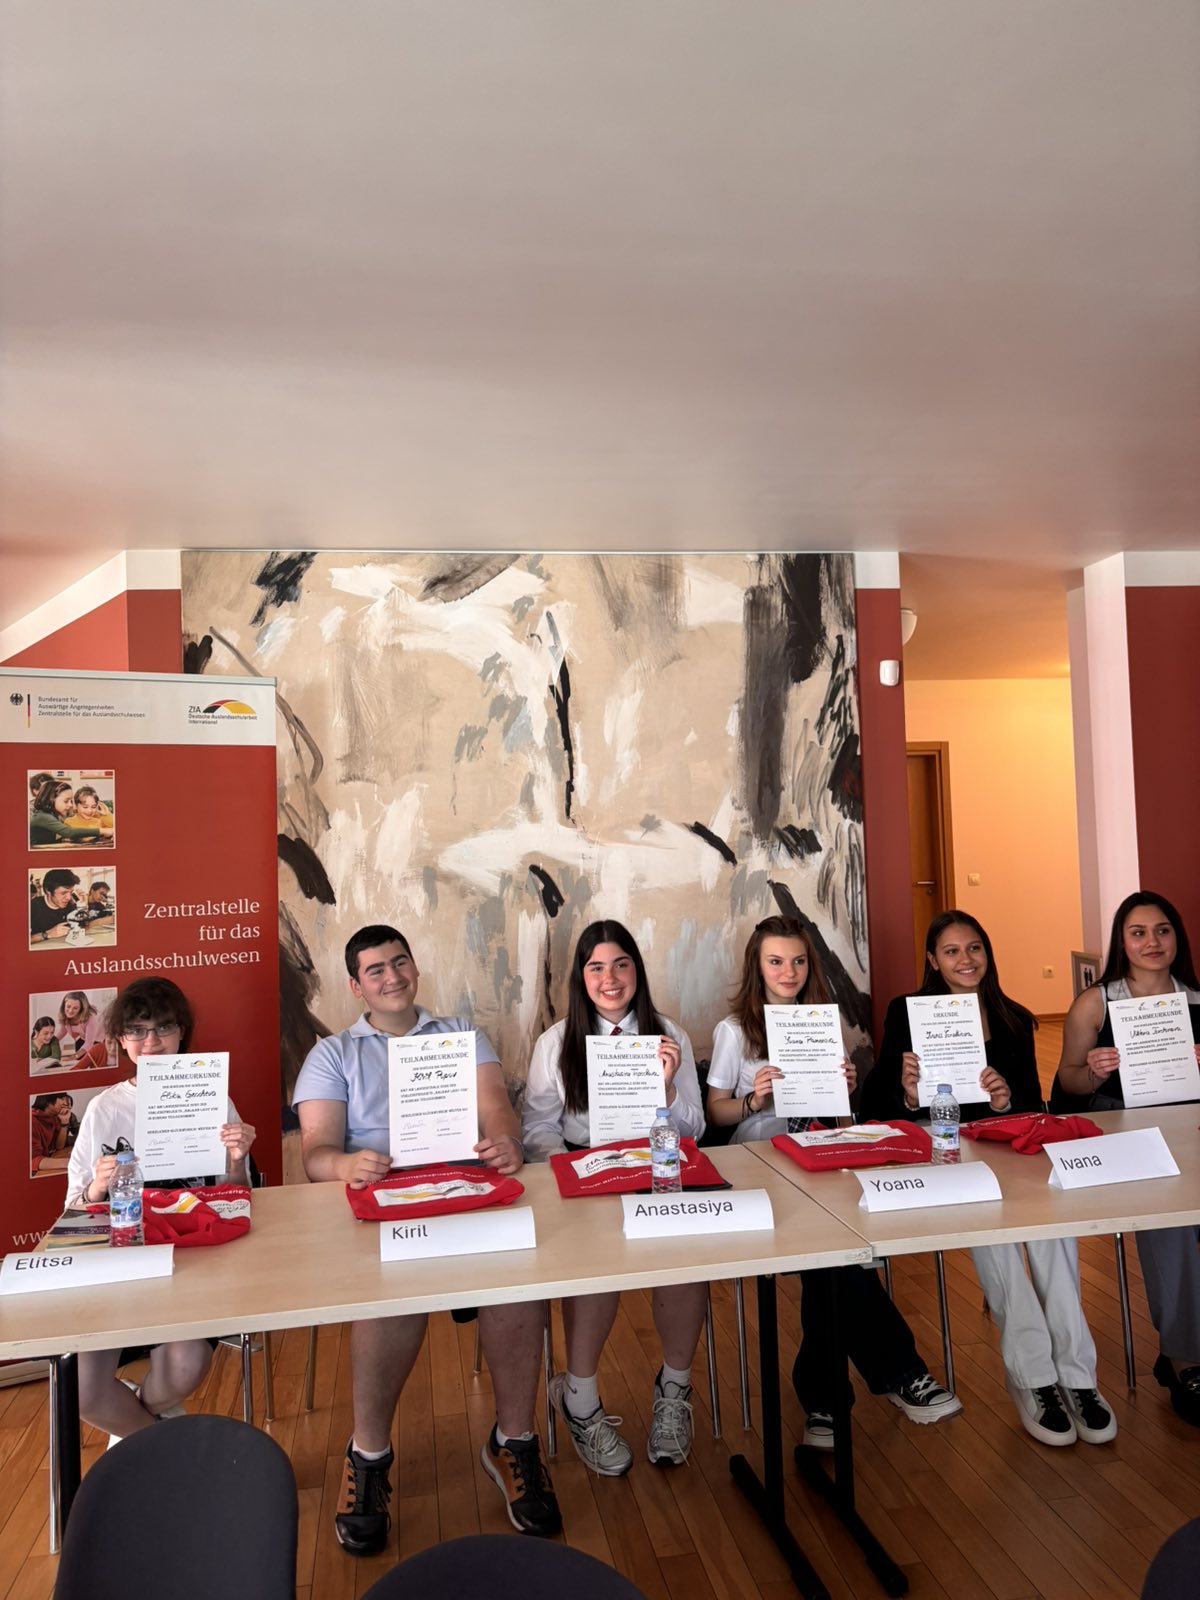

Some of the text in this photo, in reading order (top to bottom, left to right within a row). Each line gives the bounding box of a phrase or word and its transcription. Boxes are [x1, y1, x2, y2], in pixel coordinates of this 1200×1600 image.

[144, 899, 260, 919] Zentralstelle
[199, 923, 260, 941] für das
[64, 950, 260, 976] Auslandsschulwesen
[149, 1072, 221, 1082] TEILNAHMEURKUNDE
[1060, 1153, 1102, 1171] Ivana
[870, 1177, 925, 1193] Yoana
[635, 1200, 733, 1218] Anastasiya
[392, 1224, 428, 1240] Kiril
[15, 1255, 73, 1271] Elitsa
